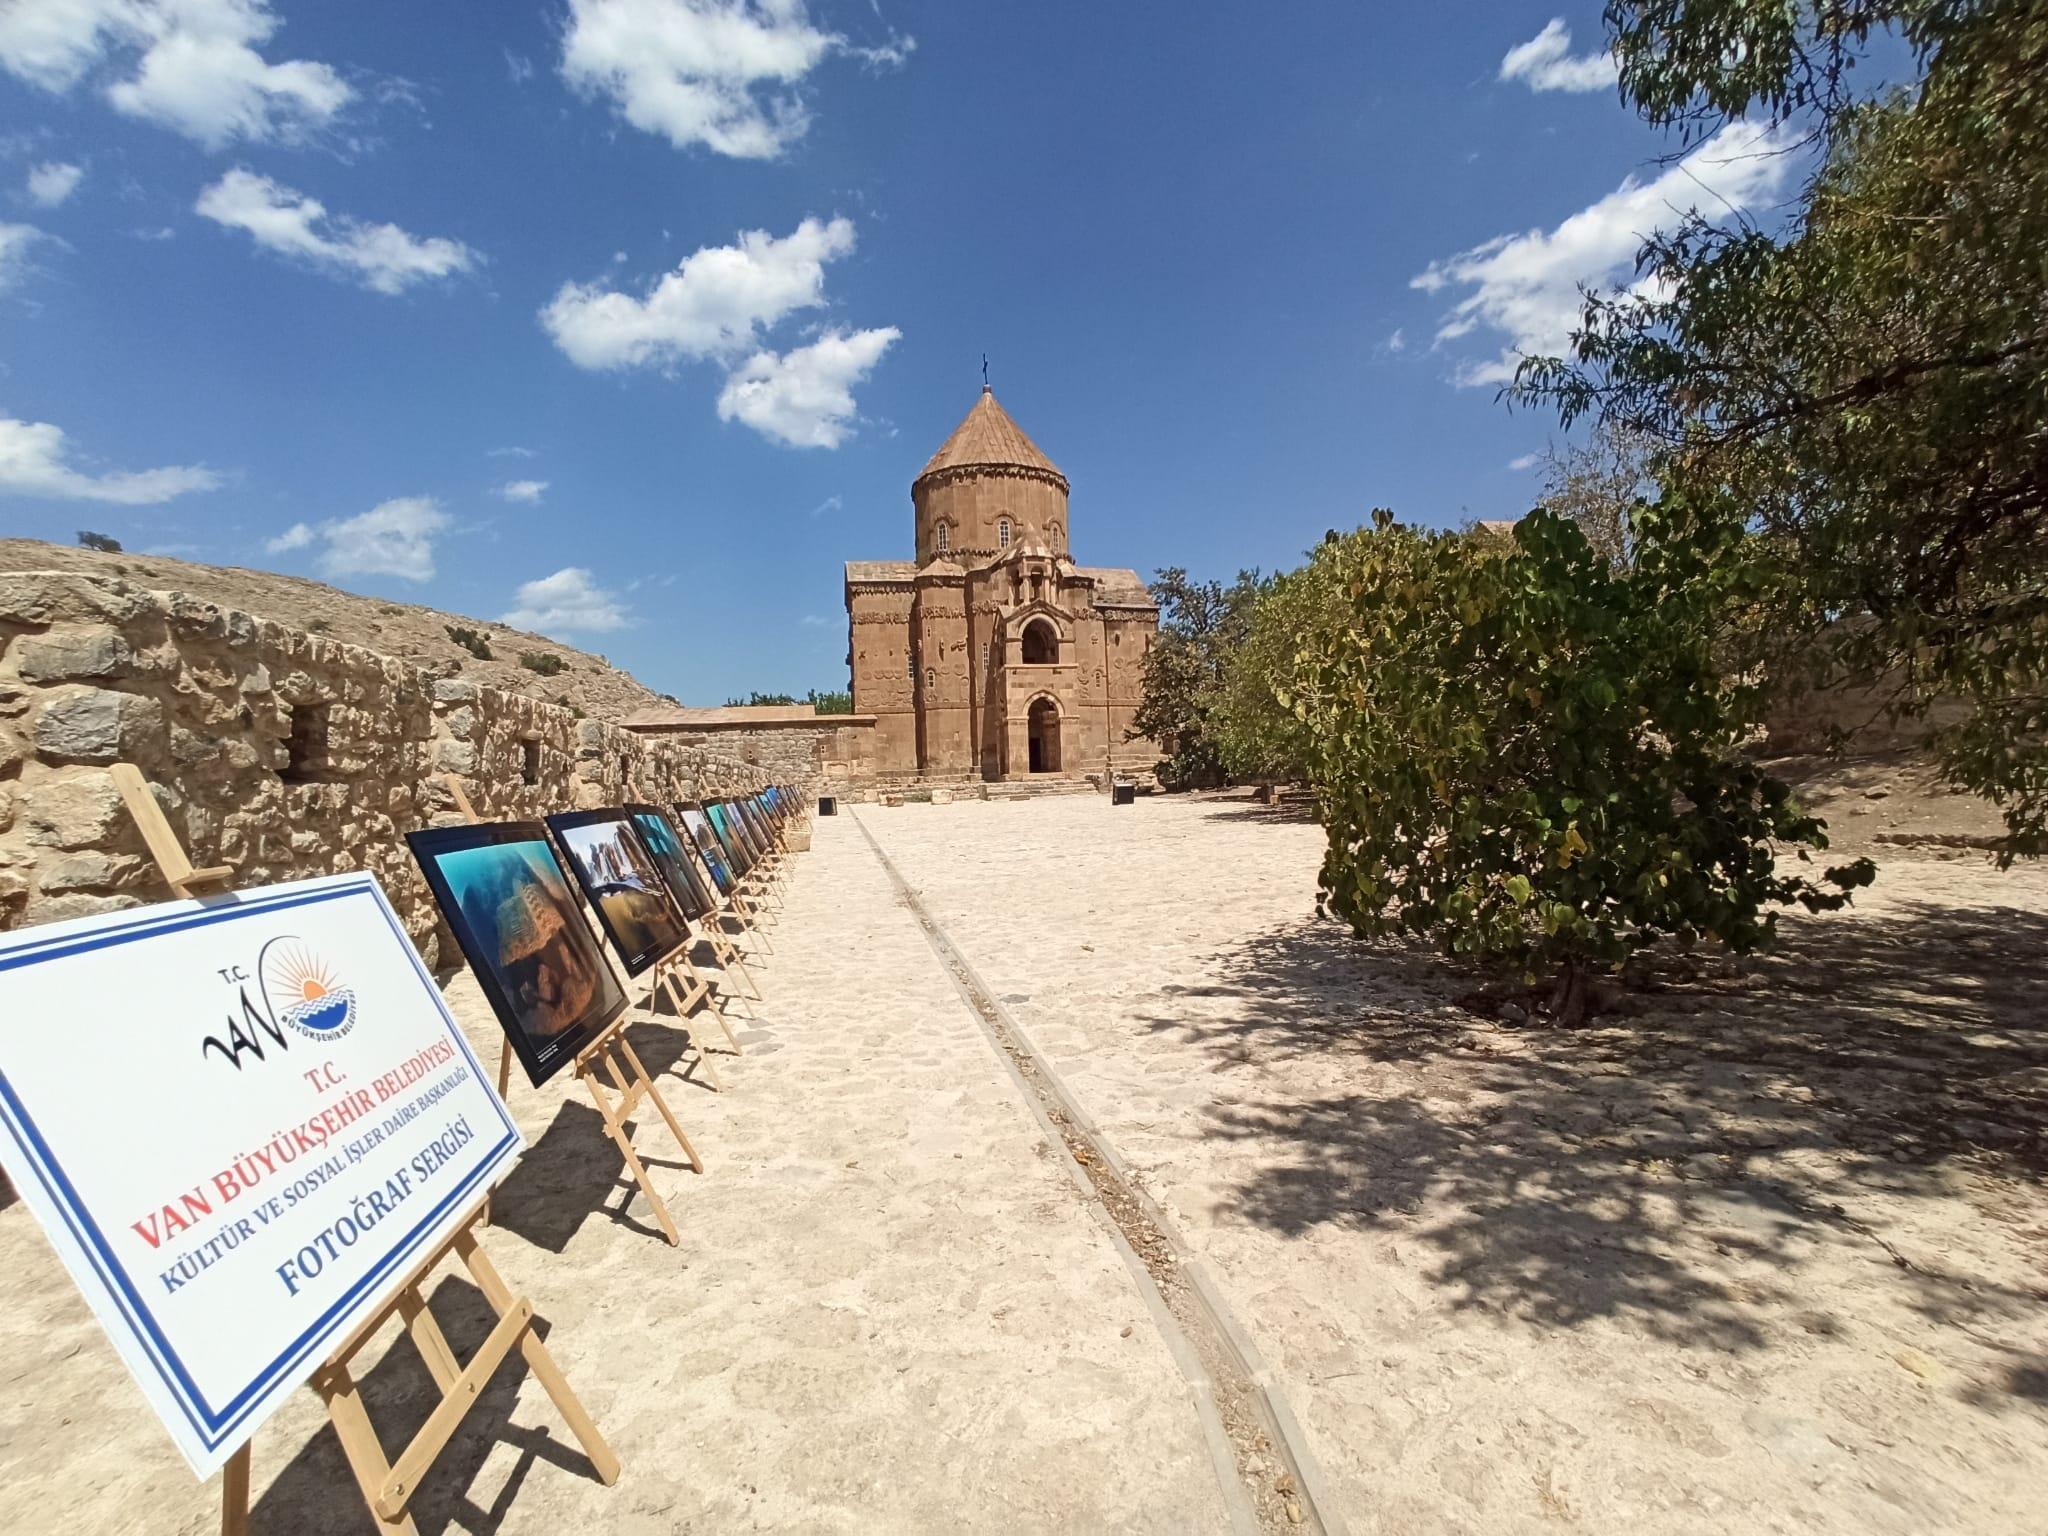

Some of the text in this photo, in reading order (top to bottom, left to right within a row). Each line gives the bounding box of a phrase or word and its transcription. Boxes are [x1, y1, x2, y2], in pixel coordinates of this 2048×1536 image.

[217, 965, 250, 984] T.C.
[130, 1034, 456, 1249] VAN BÜYÜKŞEHİR BELEDİYESİ
[303, 1061, 347, 1093] T.C.
[159, 1065, 469, 1294] KÜLTÜR VE SOSYAL İŞLER DAİRE BAŞKANLIĞI
[275, 1113, 475, 1297] FOTOĞRAF SERGİSİ
